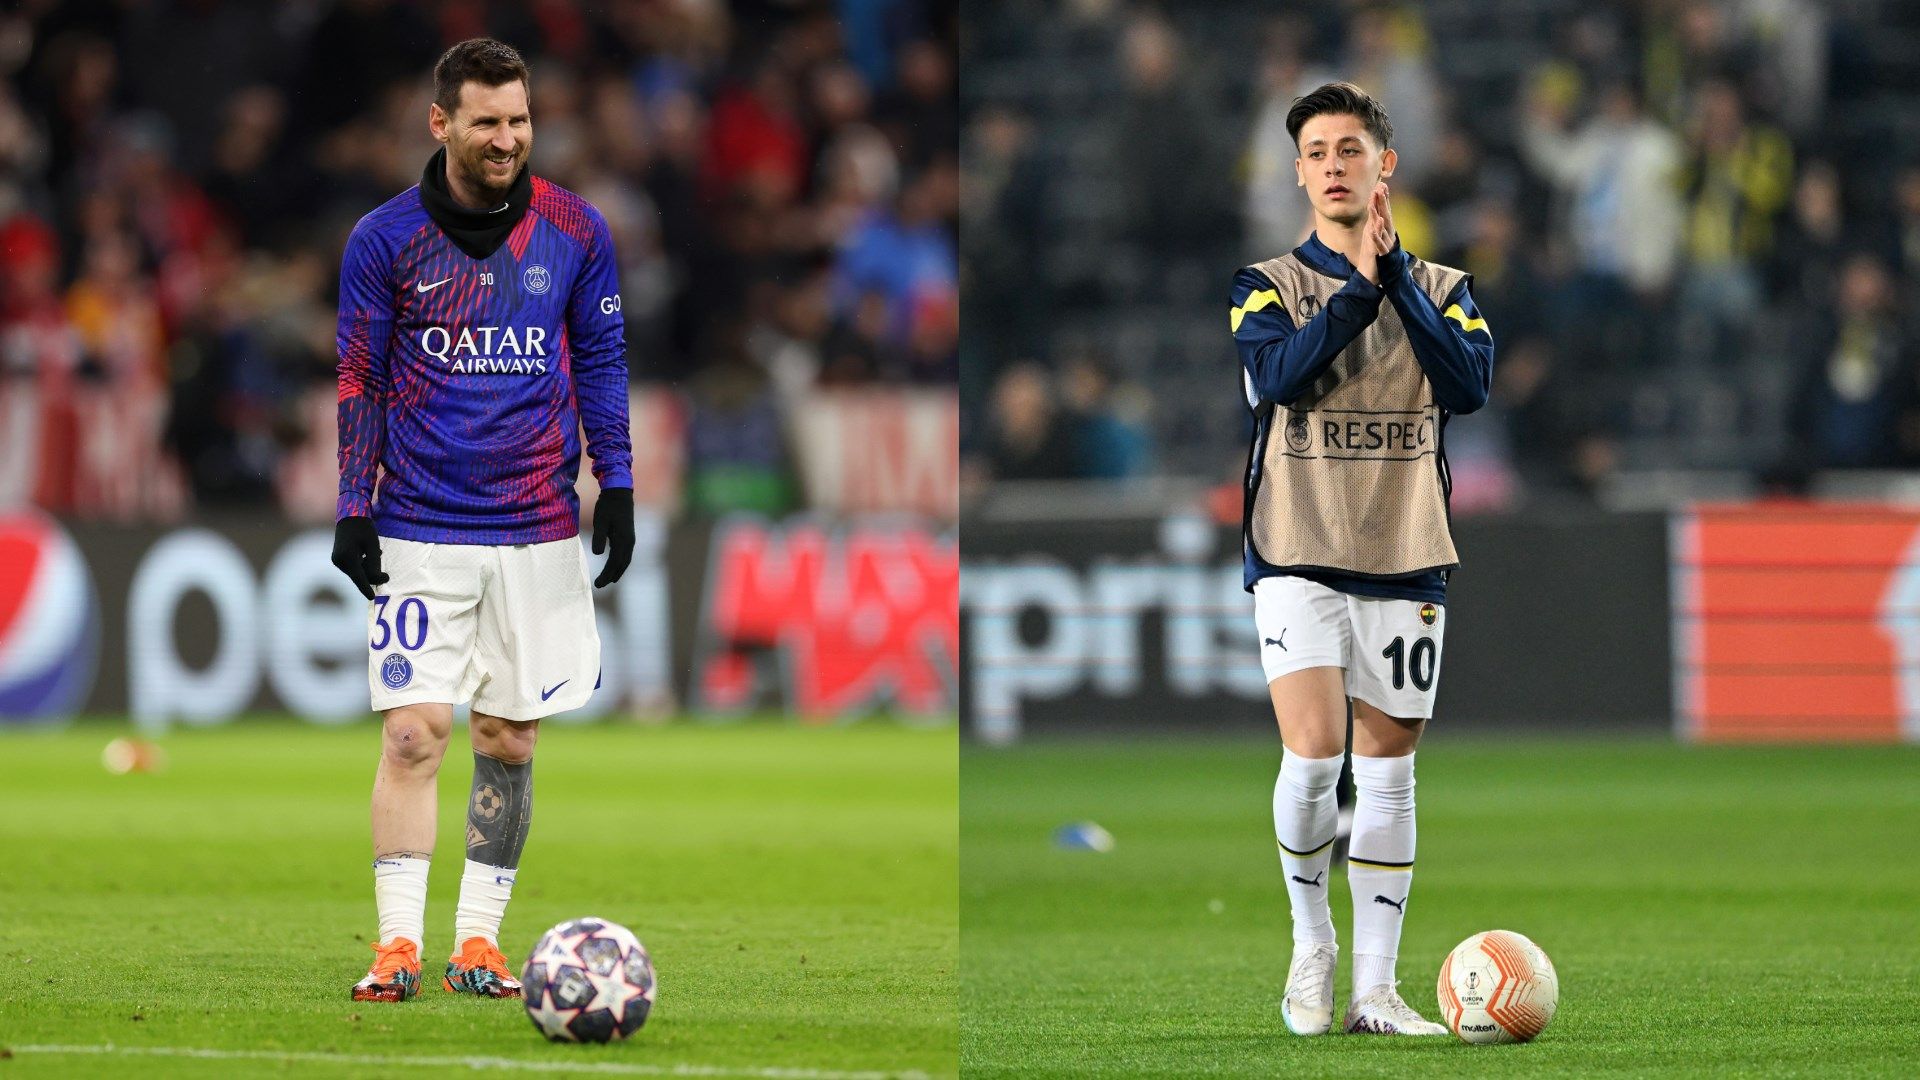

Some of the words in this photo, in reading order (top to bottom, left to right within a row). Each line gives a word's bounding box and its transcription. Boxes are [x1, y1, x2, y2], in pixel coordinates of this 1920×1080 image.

[480, 273, 494, 286] 30
[600, 294, 621, 315] GO
[421, 326, 547, 363] QATAR
[450, 358, 547, 376] AIRWAYS
[370, 595, 429, 651] 30
[1382, 636, 1437, 692] 10
[1461, 1024, 1496, 1033] molten
